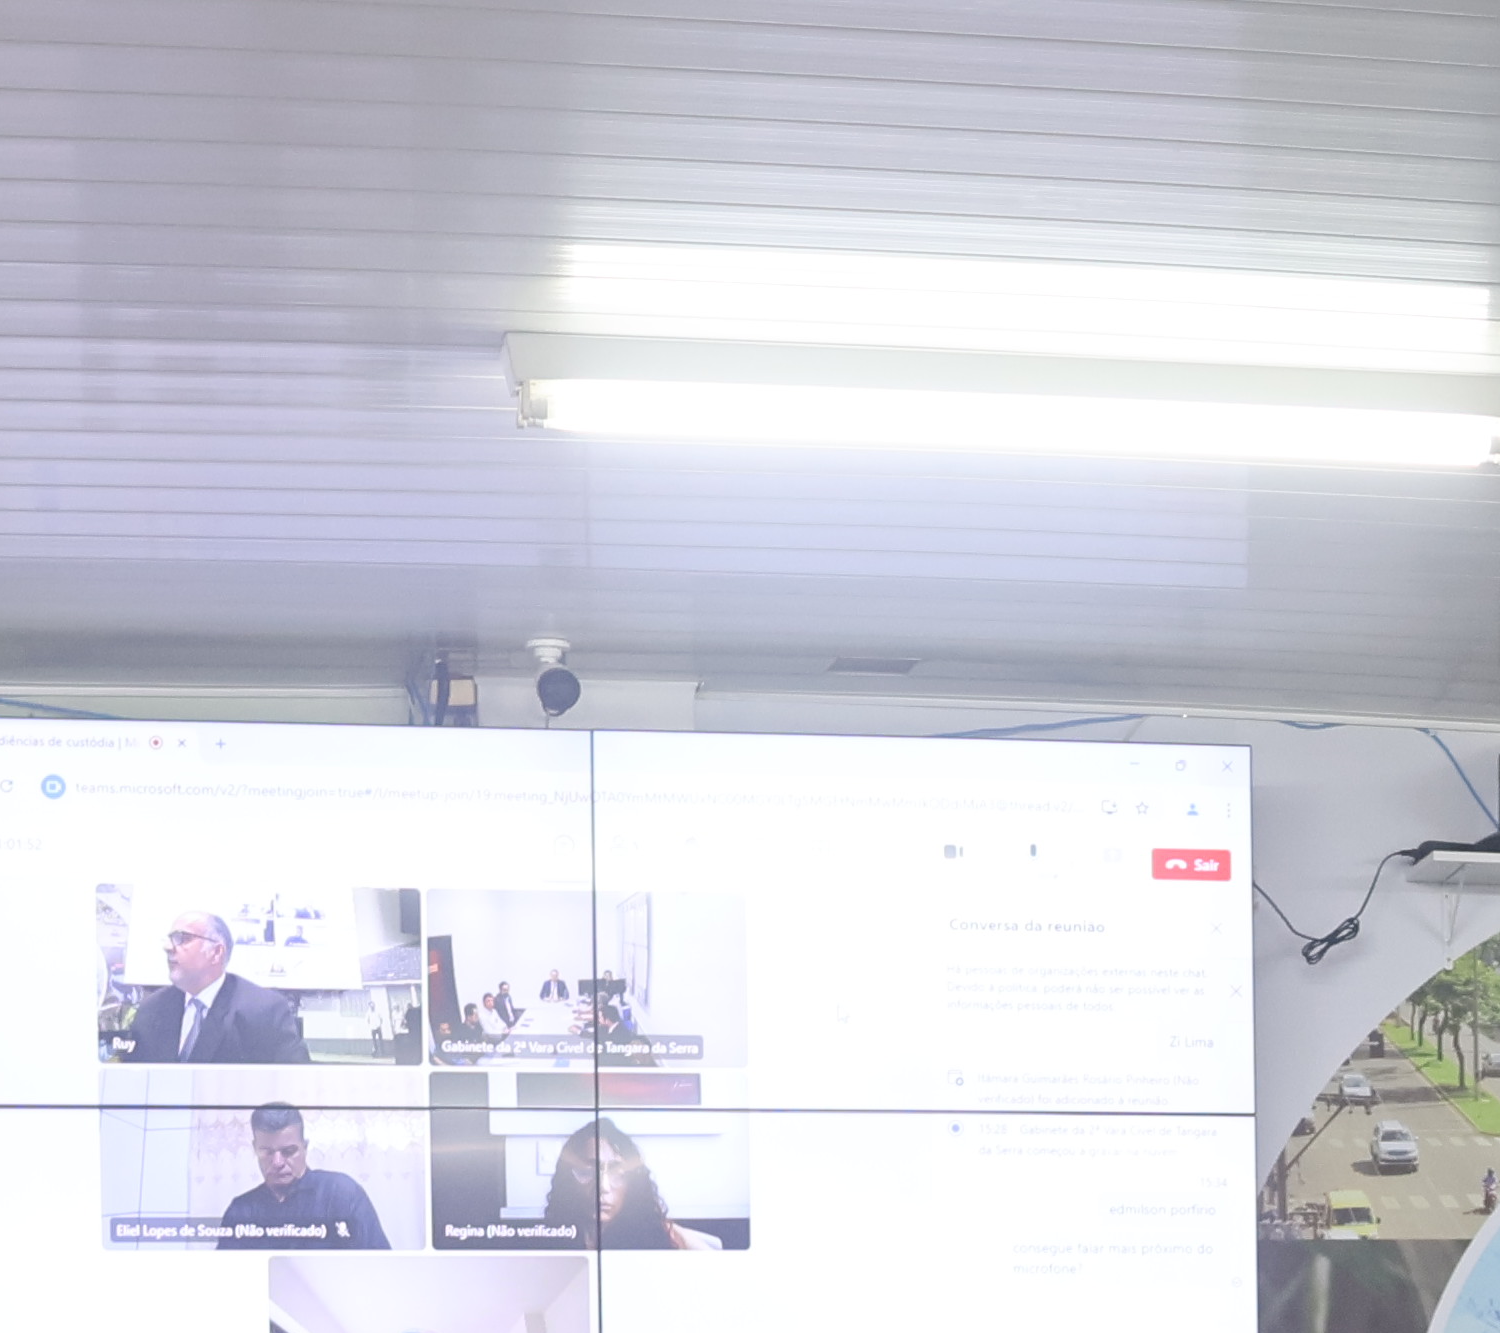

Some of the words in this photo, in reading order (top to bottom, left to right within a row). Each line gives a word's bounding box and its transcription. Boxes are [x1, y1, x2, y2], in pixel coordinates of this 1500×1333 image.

[1193, 858, 1220, 872] Sair
[949, 917, 1020, 933] Conversa
[1024, 918, 1044, 933] da
[112, 1036, 136, 1053] Ruy
[441, 1039, 495, 1053] Gabinete
[529, 1040, 555, 1053] Vara
[652, 1041, 668, 1055] da
[669, 1042, 699, 1055] Serra
[1169, 1035, 1182, 1049] Zi
[1184, 1035, 1216, 1050] Lima
[1109, 1203, 1167, 1216] edmilson
[116, 1224, 140, 1238] Eliel
[143, 1224, 178, 1240] Lopes
[180, 1224, 196, 1238] de
[197, 1224, 234, 1238] Souza
[235, 1223, 264, 1239] (Não
[266, 1223, 328, 1239] verificado)
[445, 1224, 485, 1240] Regina
[486, 1224, 516, 1240] (Não
[517, 1224, 578, 1240] verificado)
[1012, 1244, 1073, 1258] consegue
[1108, 1244, 1138, 1255] mais
[1197, 1243, 1214, 1256] do
